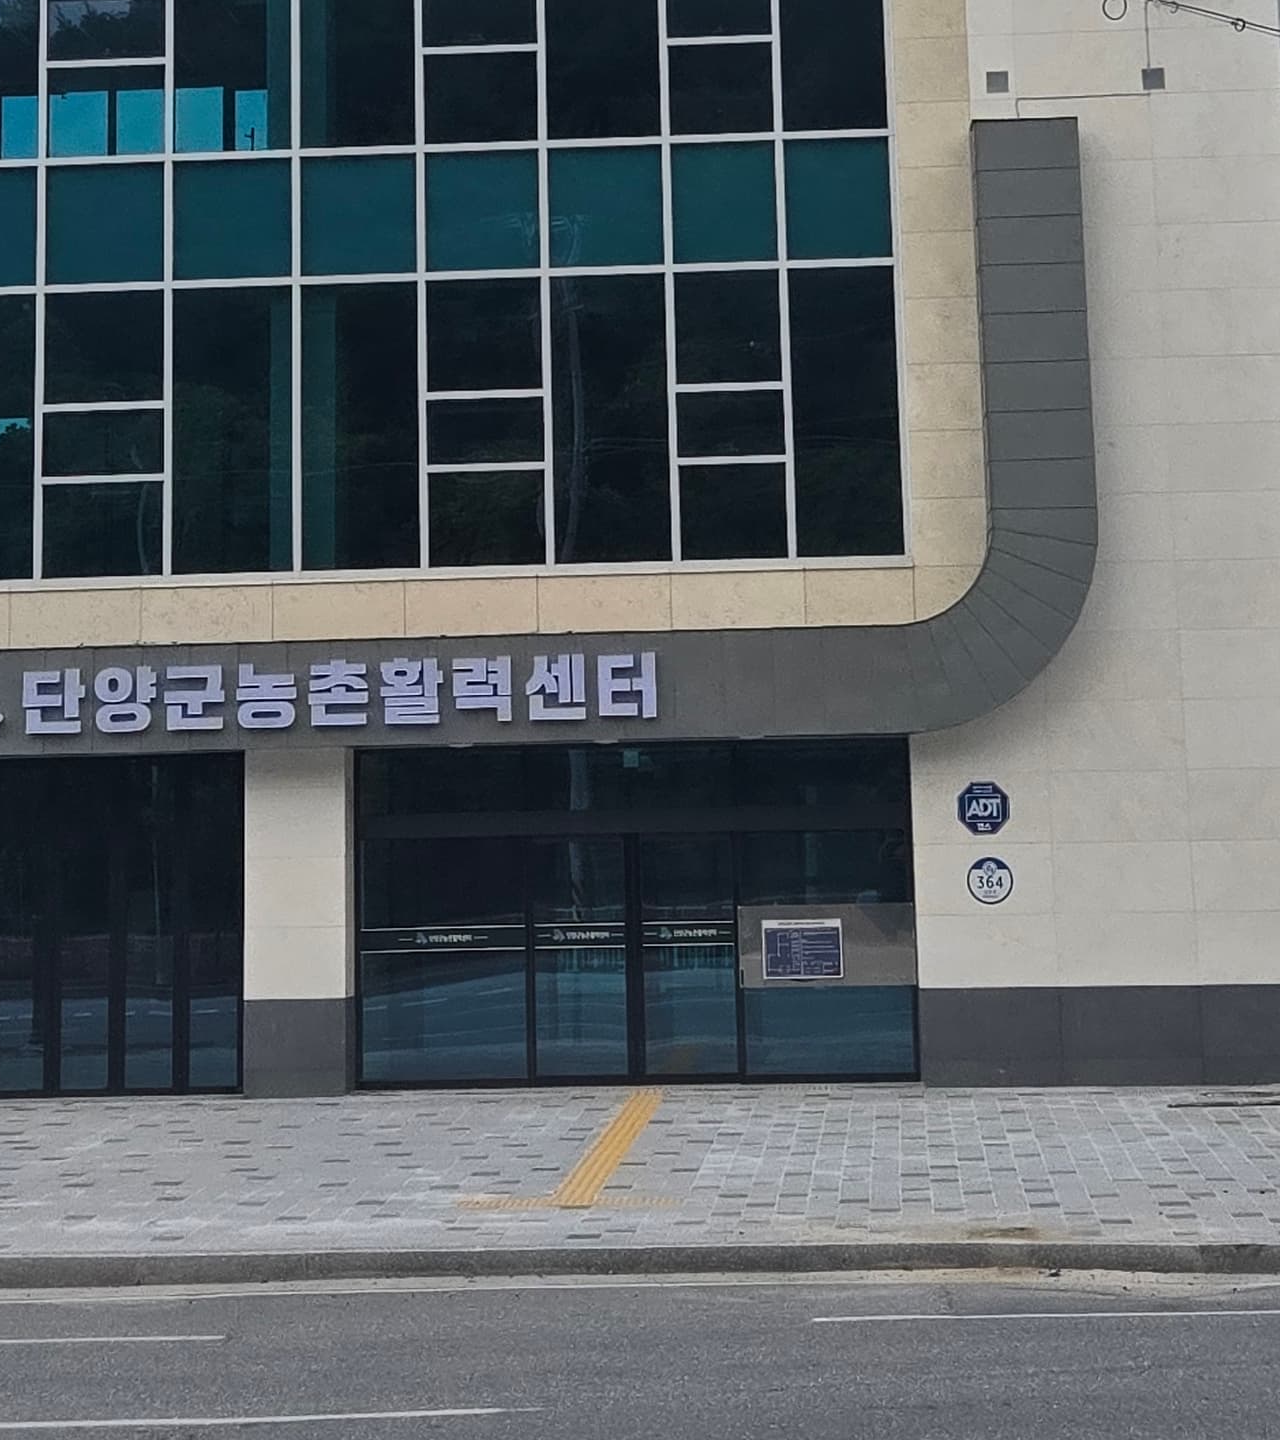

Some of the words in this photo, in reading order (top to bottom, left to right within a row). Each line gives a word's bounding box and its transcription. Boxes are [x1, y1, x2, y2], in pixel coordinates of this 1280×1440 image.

[21, 651, 658, 735] 단양군농촌활력센터
[967, 799, 1000, 817] ADT
[976, 875, 1003, 890] 364
